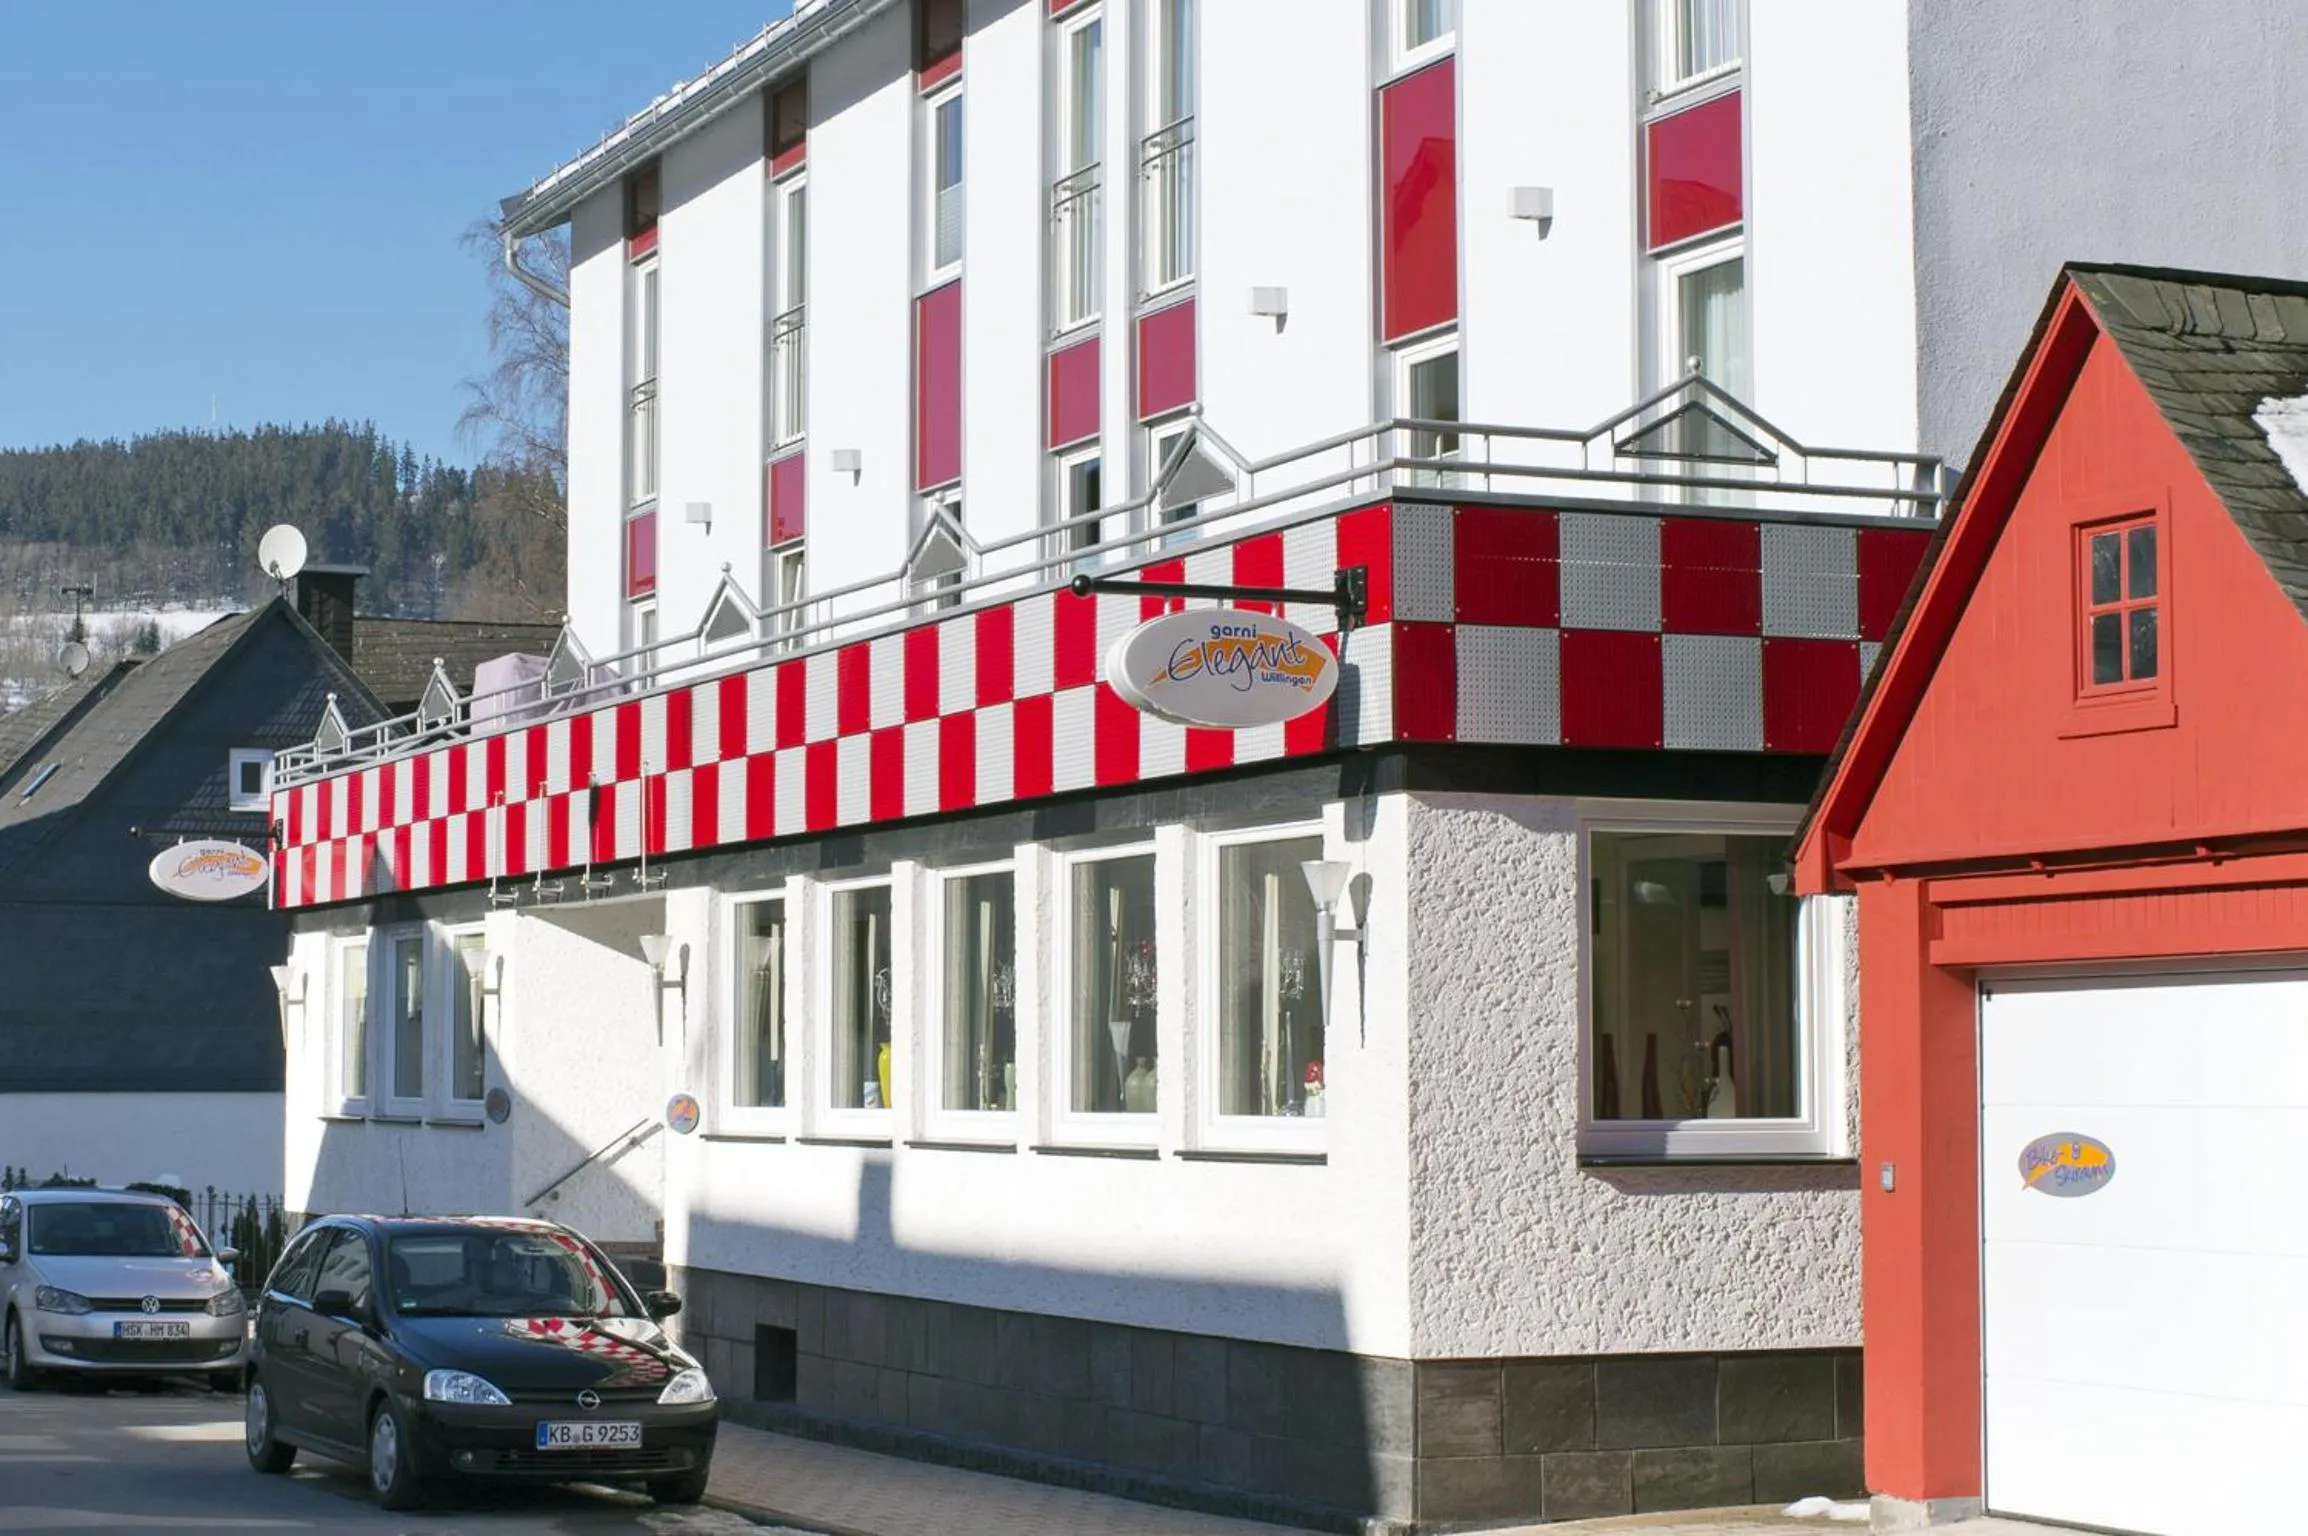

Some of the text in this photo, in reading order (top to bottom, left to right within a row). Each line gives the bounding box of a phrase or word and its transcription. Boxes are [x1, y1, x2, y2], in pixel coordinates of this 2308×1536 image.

[1210, 624, 1257, 640] garni
[1167, 630, 1306, 692] Elegant
[1260, 671, 1312, 687] Willingen
[549, 1425, 640, 1443] KB G 9253
